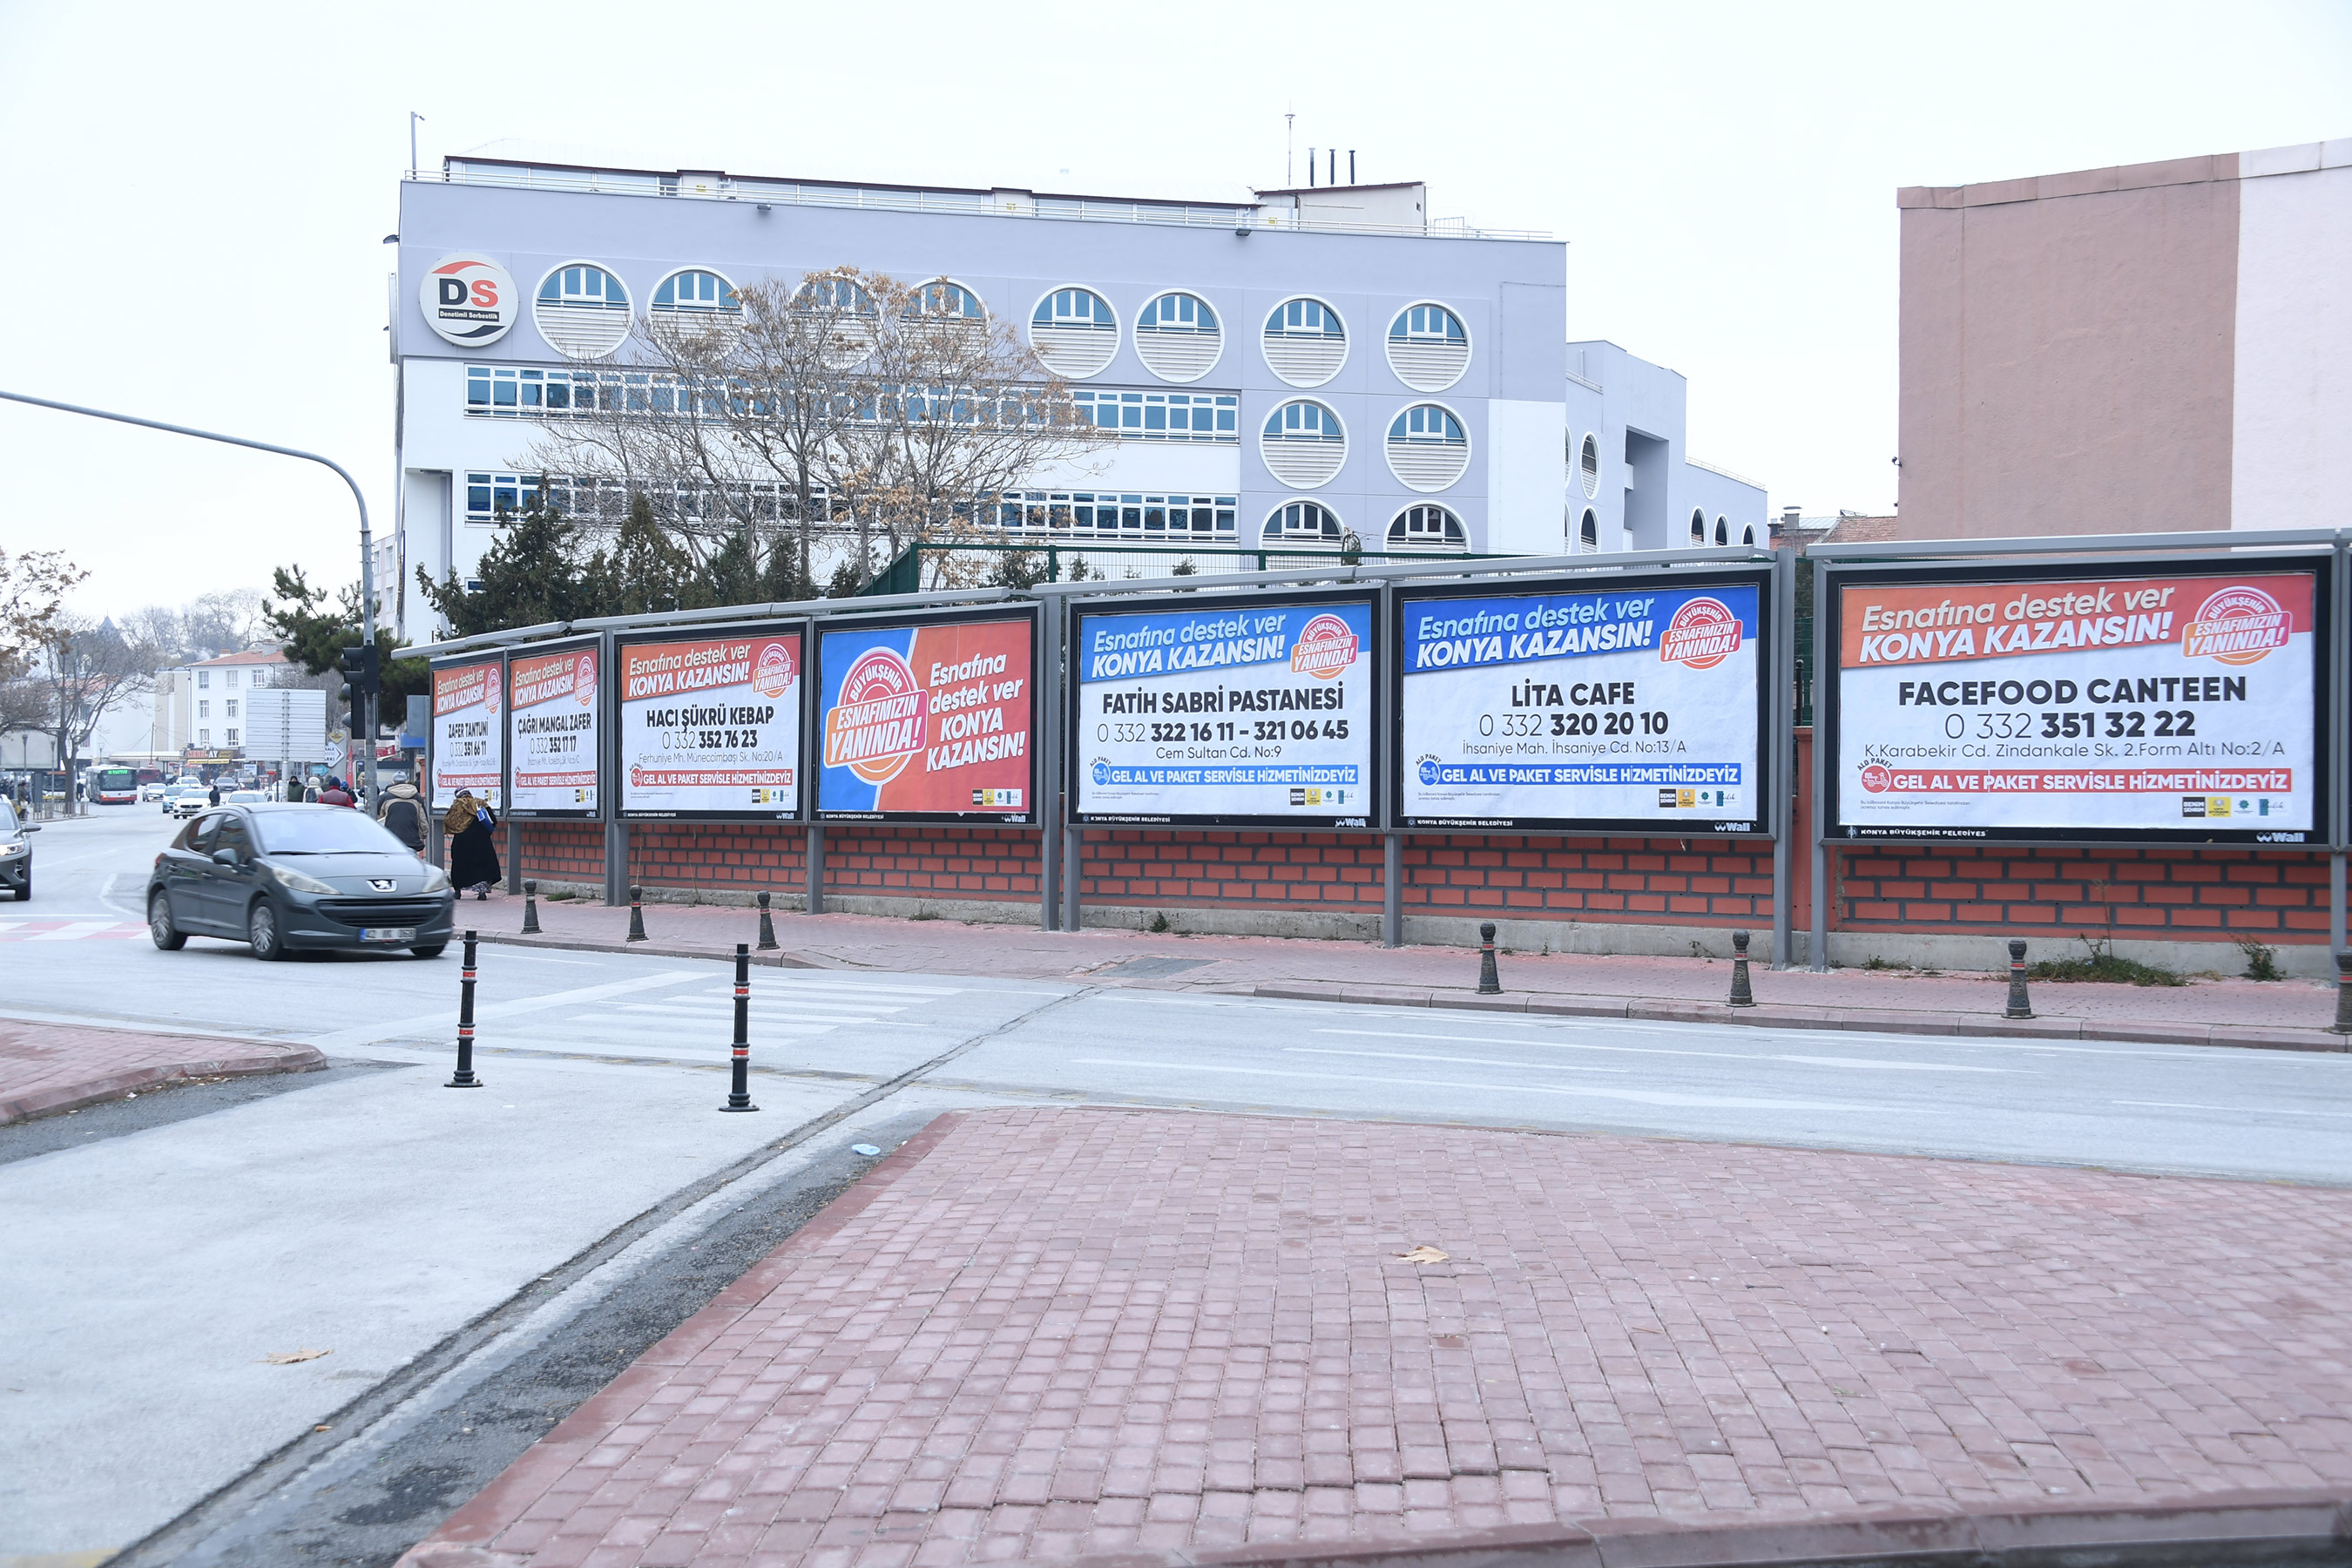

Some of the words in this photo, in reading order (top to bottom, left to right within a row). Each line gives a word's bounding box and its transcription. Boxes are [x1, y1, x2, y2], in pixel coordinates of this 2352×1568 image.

[439, 278, 498, 308] DS
[1418, 611, 1519, 640] Esnafına
[1524, 598, 1610, 630] destek
[1615, 598, 1654, 619] ver
[1680, 606, 1723, 627] BÜYÜKŞEHİR
[1862, 599, 1996, 632] Esnafına
[2004, 586, 2115, 621] destek
[2123, 586, 2175, 611] ver
[2207, 596, 2265, 619] BÜYÜKŞEHİR
[1094, 625, 1175, 652] Esnafına
[1179, 614, 1250, 643] destek
[1254, 614, 1287, 634] ver
[1668, 622, 1735, 643] ESNAFIMIZIN
[1859, 628, 1975, 662] KONYA
[1983, 612, 2173, 654] KAZANSIN!
[2194, 613, 2282, 637] ESNAFIMIZIN
[1299, 637, 1353, 656] ESNAFIMIZIN
[1416, 636, 1503, 668] KONYA
[1508, 620, 1653, 659] KAZANSIN!
[1664, 634, 1738, 660] YANINDA!
[2187, 626, 2285, 656] YANINDA!
[629, 653, 681, 676] Esnafına
[684, 644, 727, 667] destek
[731, 645, 751, 660] ver
[929, 652, 1007, 687] Esnafına
[1092, 649, 1162, 678] KONYA
[1166, 635, 1286, 671] KAZANSIN!
[1294, 647, 1355, 672] YANINDA!
[514, 685, 537, 706] KONYA
[537, 673, 574, 700] KAZANSIN!
[629, 672, 673, 697] KONYA
[676, 661, 750, 690] KAZANSIN!
[754, 672, 792, 693] YANINDA!
[850, 665, 902, 702] BÜYÜKŞEHİR
[1899, 679, 2078, 706] FACEFOOD
[2087, 676, 2246, 704] CANTEEN
[929, 682, 990, 714] destek
[993, 679, 1024, 702] ver
[1103, 686, 1157, 713] FATİH
[1161, 685, 1223, 713] SABRİ
[1229, 681, 1343, 713] PASTANESİ
[1512, 678, 1564, 707] LİTA
[1570, 682, 1634, 706] CAFE
[539, 715, 568, 733] MANGAL
[570, 713, 591, 732] ZAFER
[646, 709, 678, 727] HACI
[681, 703, 727, 732] ŞÜKRÜ
[730, 706, 774, 726] KEBAP
[836, 694, 920, 730] ESNAFIMIZIN
[940, 707, 1004, 742] KONYA
[1479, 714, 1494, 737] 0
[1502, 713, 1542, 736] 332
[1550, 713, 1598, 736] 320
[1604, 712, 1634, 735] 20
[1639, 711, 1668, 735] 10
[1944, 713, 1964, 739] 0
[1977, 713, 2031, 739] 332
[2040, 712, 2094, 739] 351
[2105, 712, 2145, 738] 32
[2153, 710, 2195, 737] 22
[449, 723, 464, 739] ZAFER
[662, 732, 671, 749] 0
[674, 732, 695, 749] 332
[699, 731, 721, 748] 352
[725, 730, 739, 748] 76
[741, 730, 758, 747] 23
[830, 716, 923, 762] YANINDA!
[1097, 723, 1109, 742] 0
[1114, 723, 1146, 742] 332
[1151, 722, 1186, 742] 322
[1190, 722, 1212, 741] 16
[1216, 721, 1234, 741] 11
[1254, 720, 1286, 740] 321
[1291, 720, 1318, 740] 06
[1322, 720, 1348, 740] 45
[549, 737, 561, 753] 352
[926, 732, 1026, 772] KAZANSIN!
[1156, 747, 1184, 759] Cem
[1187, 747, 1227, 759] Sultan
[1230, 746, 1251, 759] Cd.
[1254, 746, 1281, 758] No:9
[1463, 740, 1512, 757] İhsaniye
[1517, 742, 1548, 754] Mah.
[1552, 739, 1606, 756] İhsaniye
[1610, 740, 1632, 754] Cd.
[1636, 739, 1686, 754] No:13/A
[1865, 744, 1957, 758] K.Karabekir
[1962, 744, 1990, 758] Cd.
[1996, 743, 2089, 757] Zindankale
[2094, 742, 2119, 757] Sk.
[2124, 742, 2181, 756] 2.Form
[2186, 741, 2215, 756] Altı
[2221, 740, 2285, 757] No:2/A
[1112, 770, 1132, 783] GEL
[1134, 770, 1148, 783] AL
[1150, 770, 1165, 783] VE
[1167, 770, 1201, 783] PAKET
[1204, 767, 1254, 782] SERVİSLE
[1257, 766, 1355, 782] HİZMETİNİZDEYİZ
[1442, 769, 1467, 782] GEL
[1470, 769, 1486, 782] AL
[1489, 769, 1507, 782] VE
[1511, 769, 1551, 782] PAKET
[1554, 765, 1618, 782] SERVİSLE
[1620, 765, 1738, 782] HİZMETİNİZDEYİZ
[1857, 760, 1869, 772] ALO
[1870, 758, 1893, 769] PAKET
[643, 774, 656, 784] GEL
[658, 774, 666, 784] AL
[667, 774, 676, 784] VE
[678, 774, 699, 784] PAKET
[1894, 775, 1927, 790] GEL
[1930, 775, 1952, 790] AL
[1956, 775, 1978, 790] VE
[1984, 774, 2038, 790] PAKET
[2043, 770, 2126, 790] SERVİSLE
[2129, 770, 2288, 789] HİZMETİNİZDEYİZ
[1726, 822, 1750, 831] Wall
[2271, 832, 2305, 842] Wall
